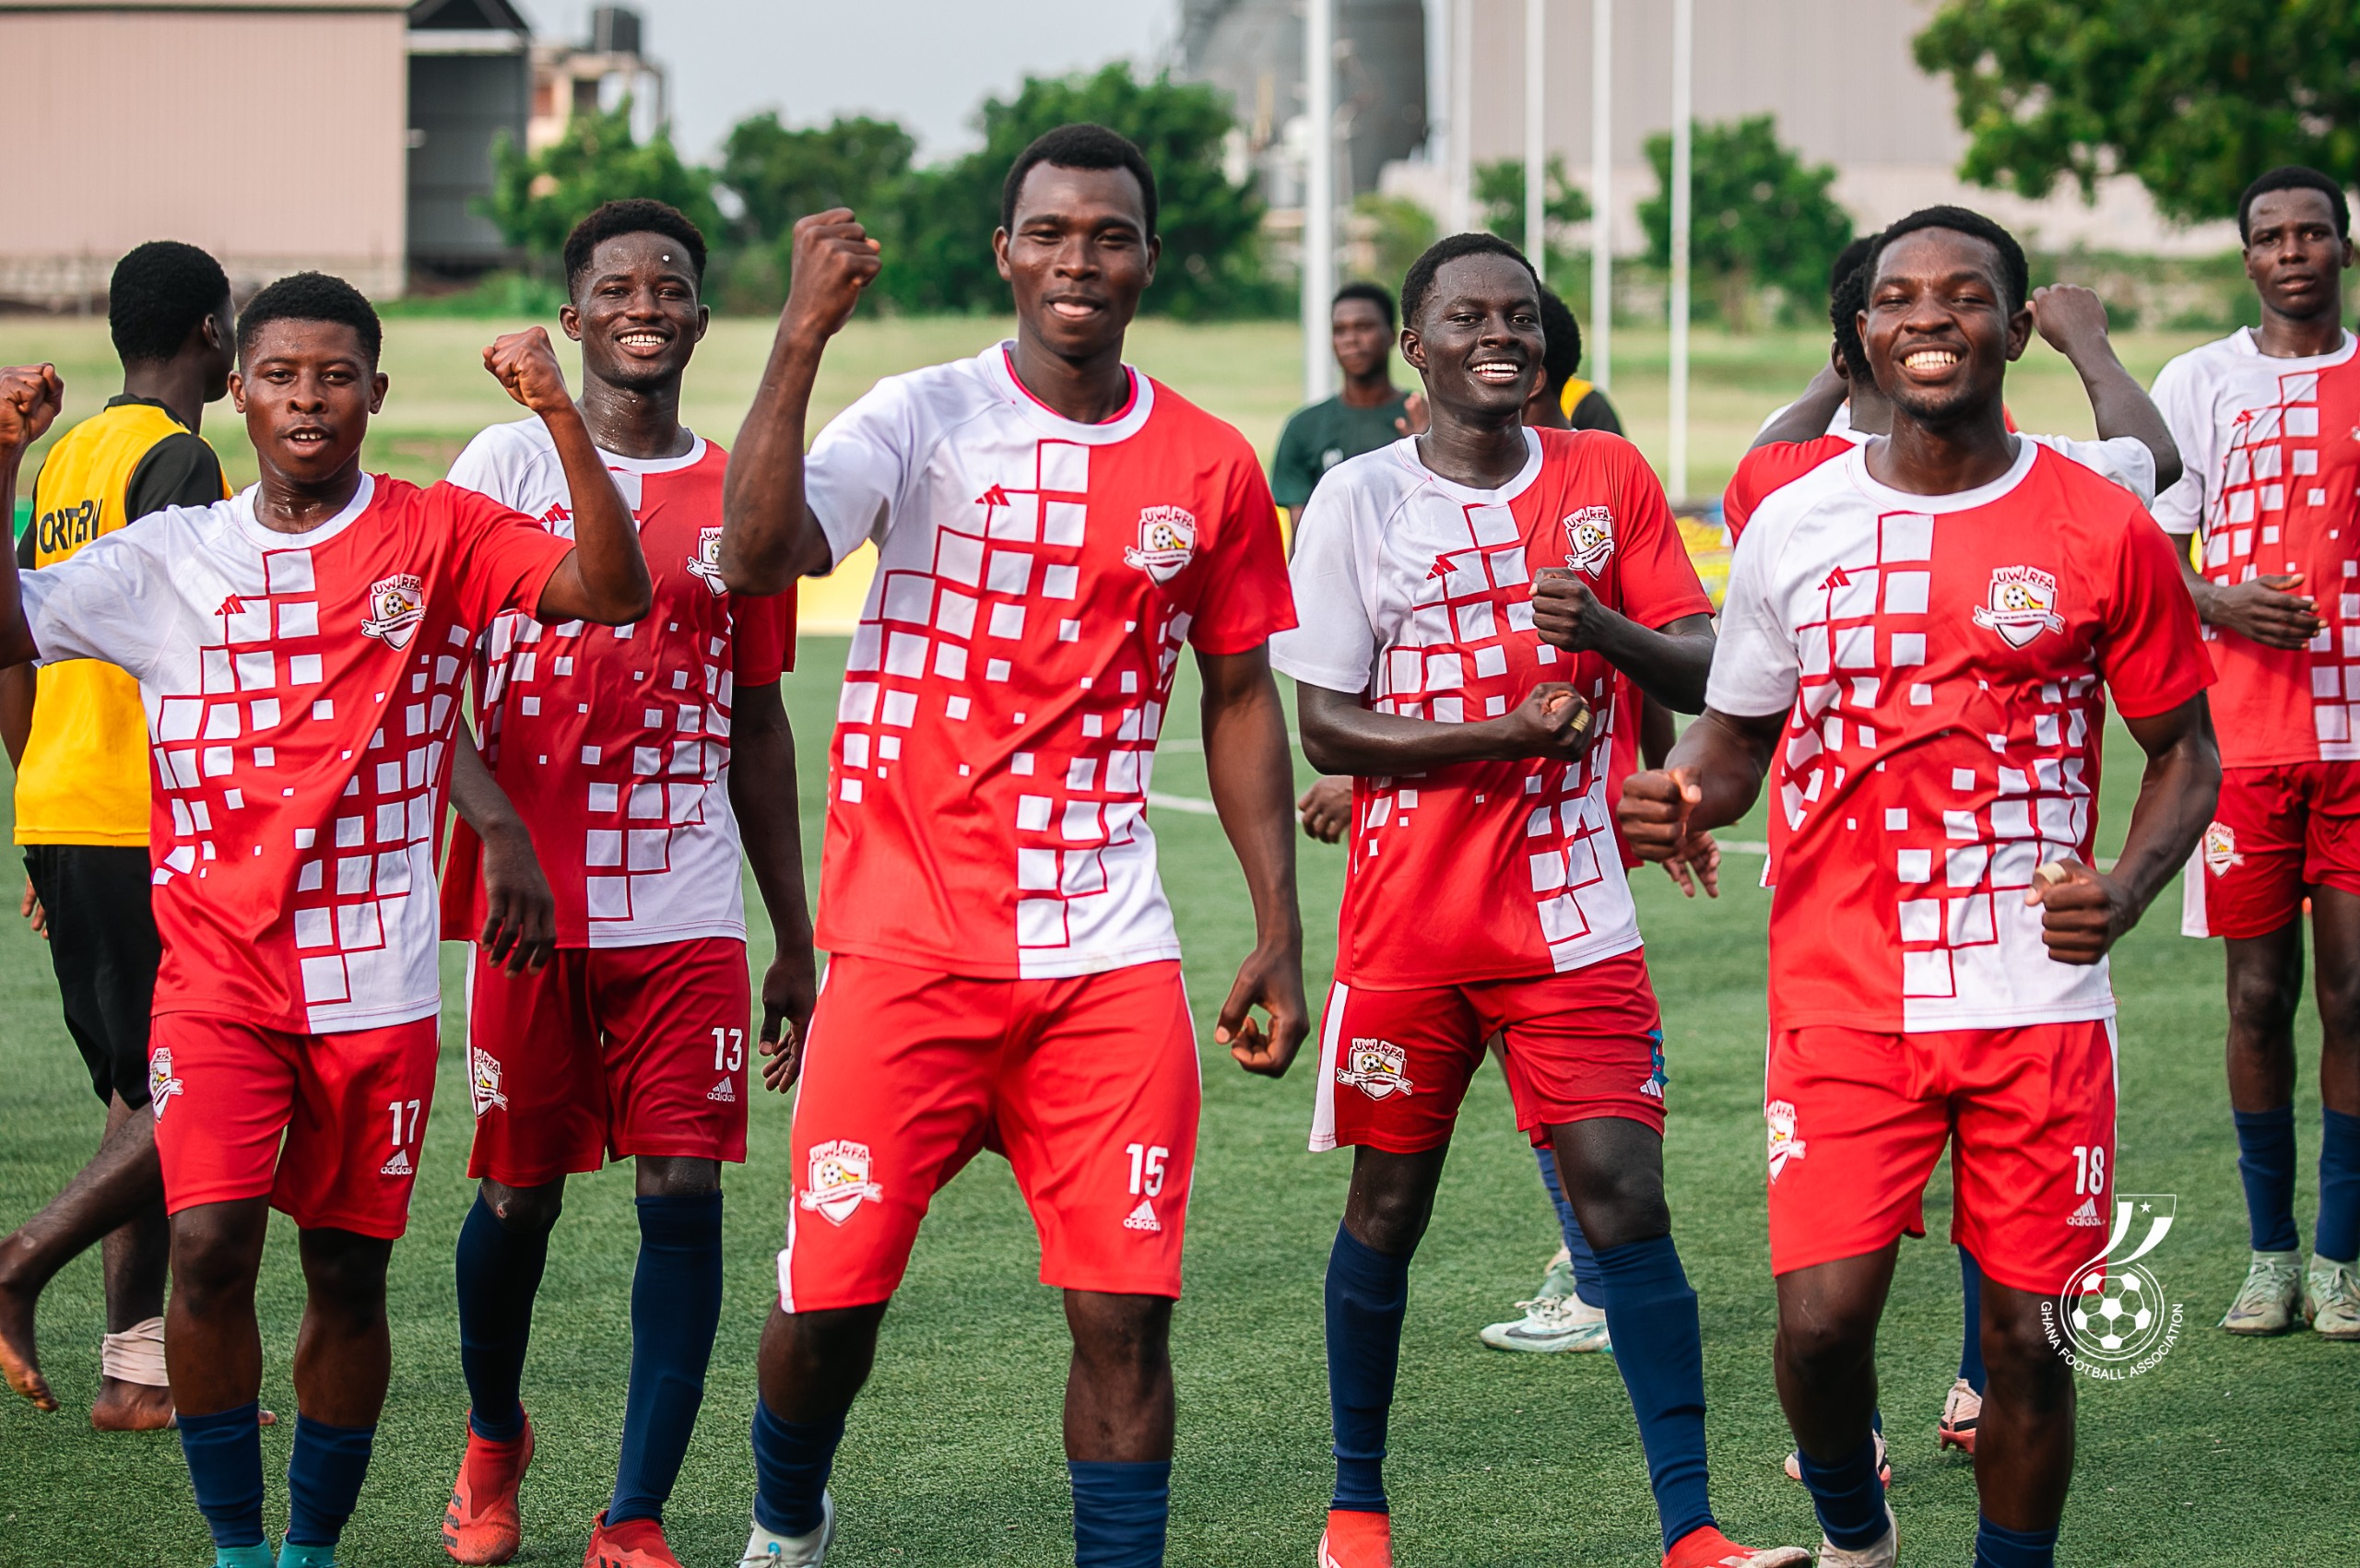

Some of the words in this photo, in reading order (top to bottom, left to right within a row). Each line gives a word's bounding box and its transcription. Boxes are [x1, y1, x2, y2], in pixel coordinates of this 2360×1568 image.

[1174, 511, 1194, 529] RFA
[1589, 508, 1610, 520] RFA
[373, 577, 397, 595] UW
[401, 576, 421, 590] RFA
[2028, 571, 2054, 590] RFA
[711, 1027, 743, 1072] 13
[1381, 1043, 1403, 1060] RFA
[483, 1054, 500, 1074] RFA
[706, 1091, 736, 1102] adidas
[388, 1099, 420, 1146] 17
[841, 1145, 867, 1161] RFA
[380, 1165, 413, 1175] adidas
[1126, 1143, 1170, 1197] 15
[2072, 1145, 2105, 1196] 18
